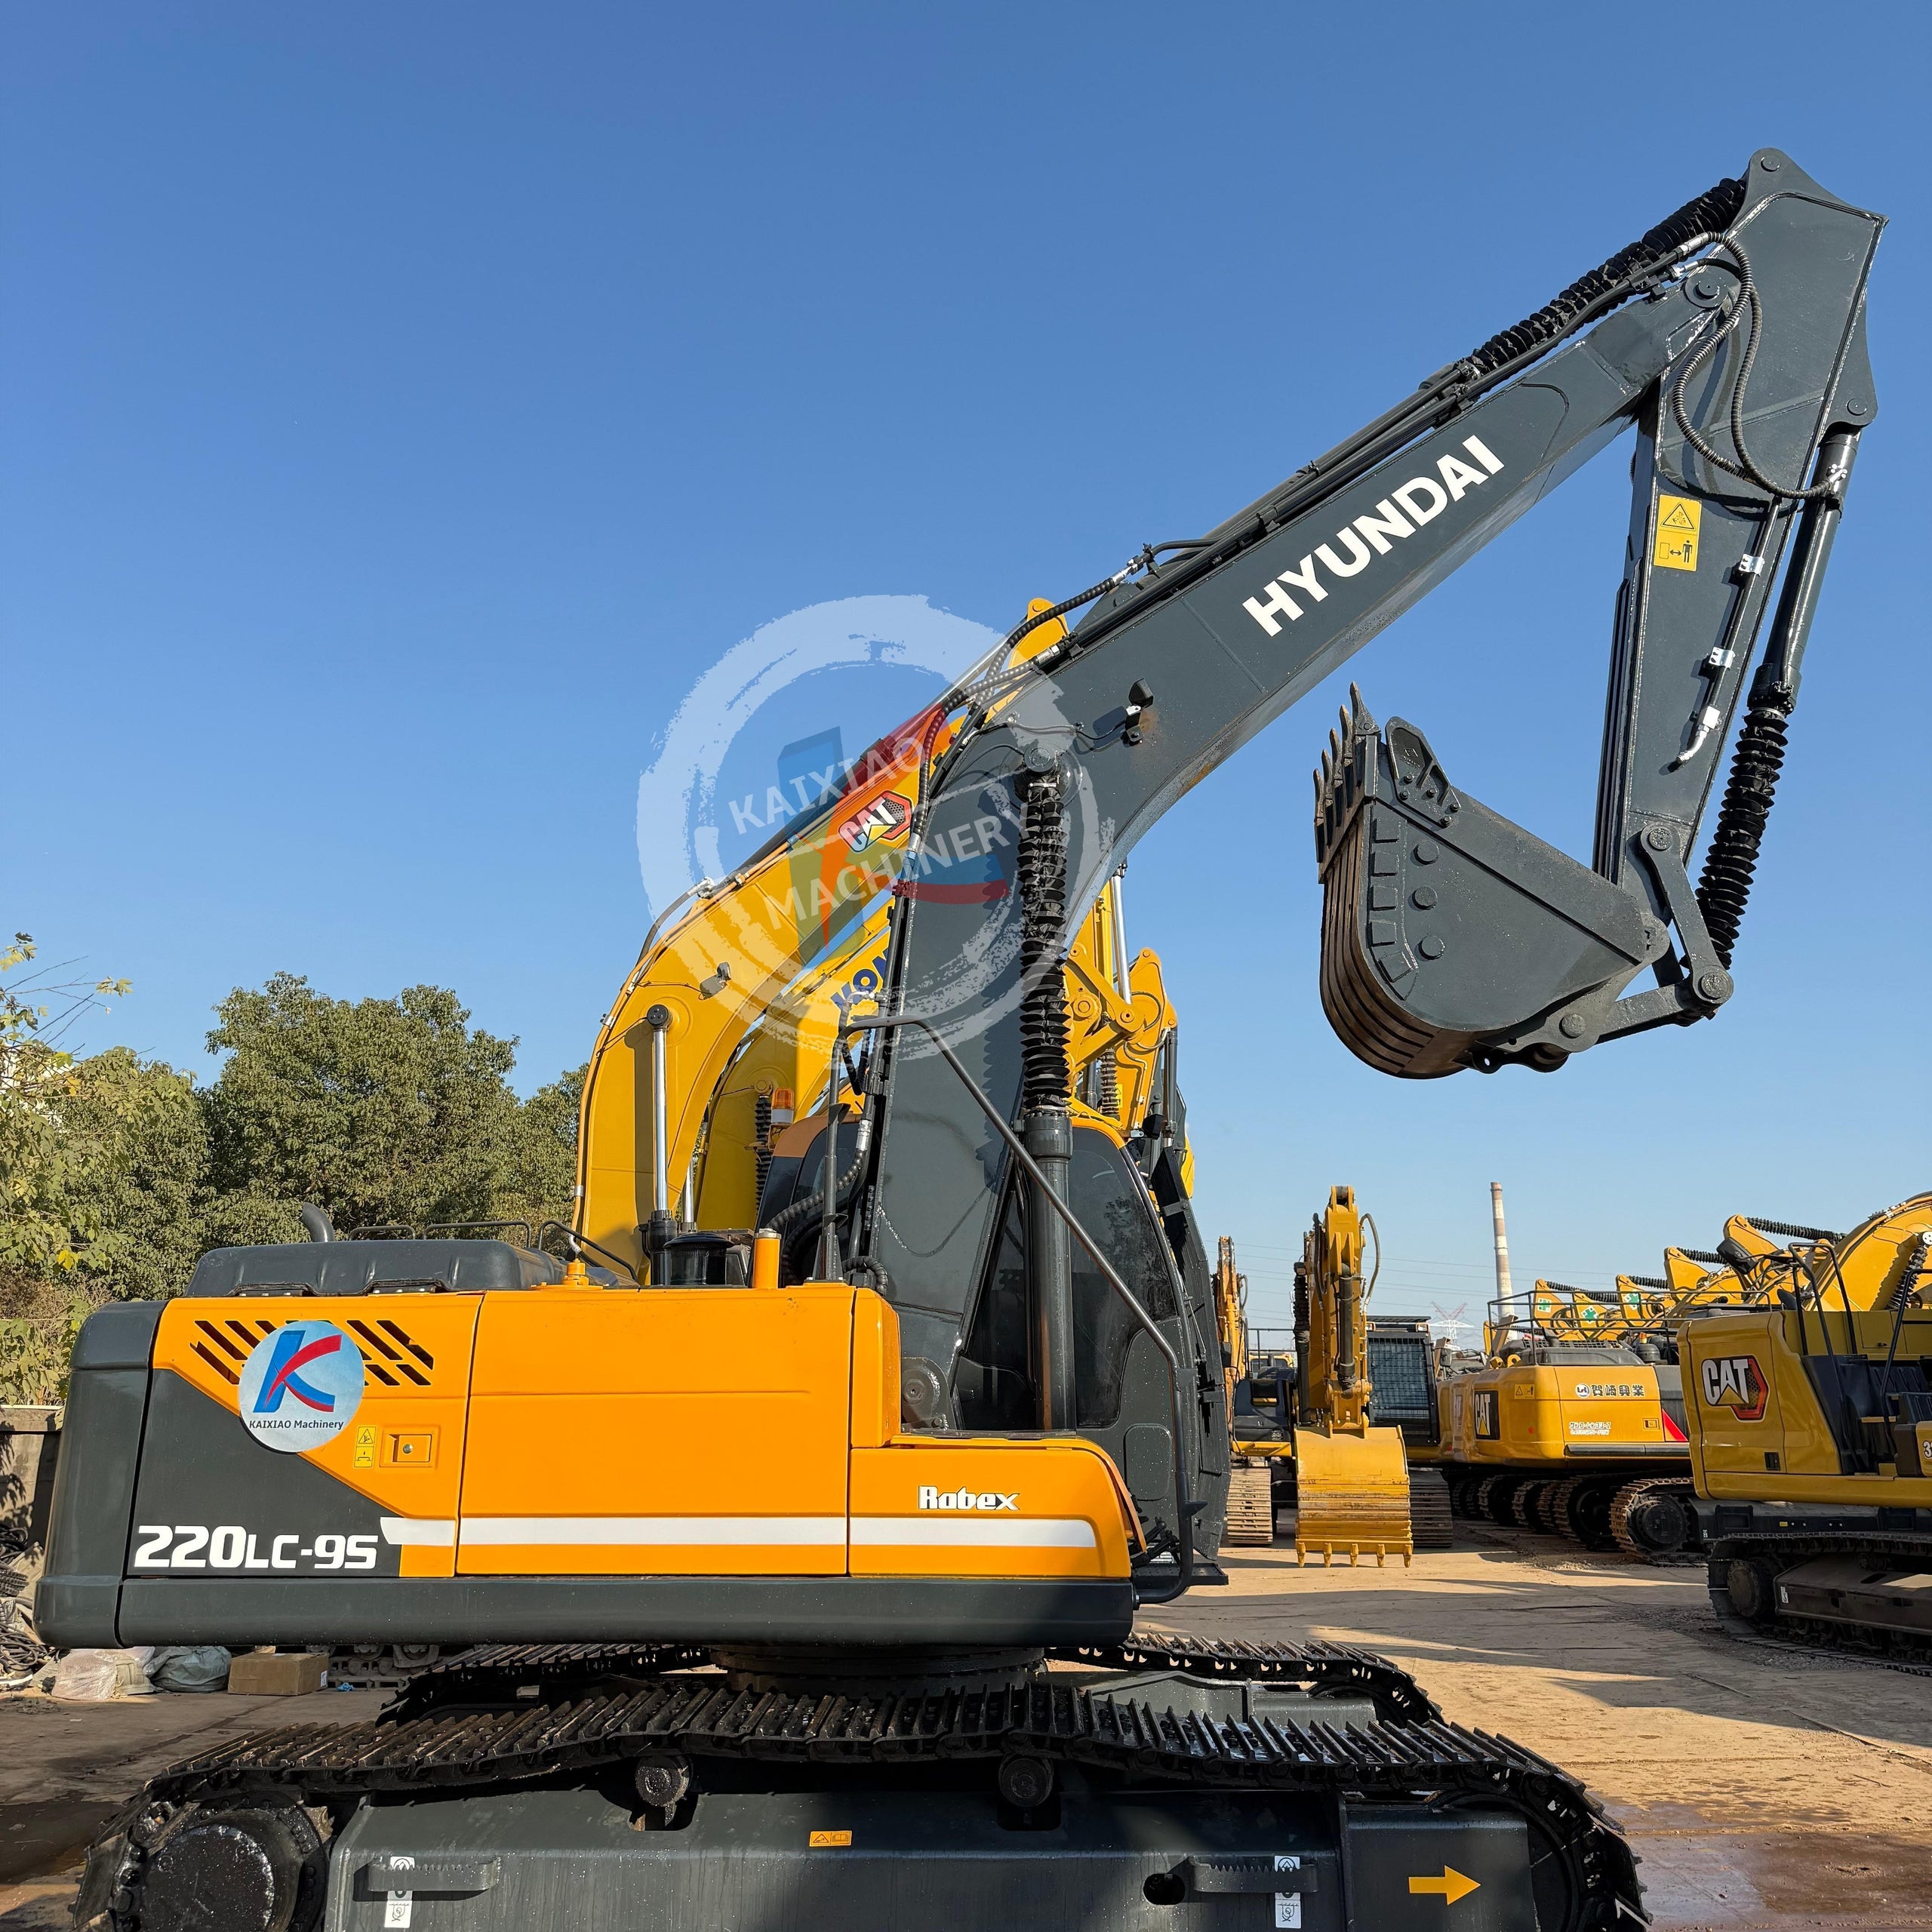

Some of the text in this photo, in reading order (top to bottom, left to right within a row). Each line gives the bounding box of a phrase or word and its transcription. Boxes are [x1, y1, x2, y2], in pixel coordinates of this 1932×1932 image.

[1242, 435, 1505, 637] HYUNDAI
[839, 795, 897, 853] CAT
[1702, 1358, 1749, 1405] CAT
[250, 1420, 343, 1430] KAIXIAO Machinery
[1475, 1393, 1491, 1435] CAT
[1922, 1440, 1932, 1459] 3
[918, 1484, 1020, 1510] Robex
